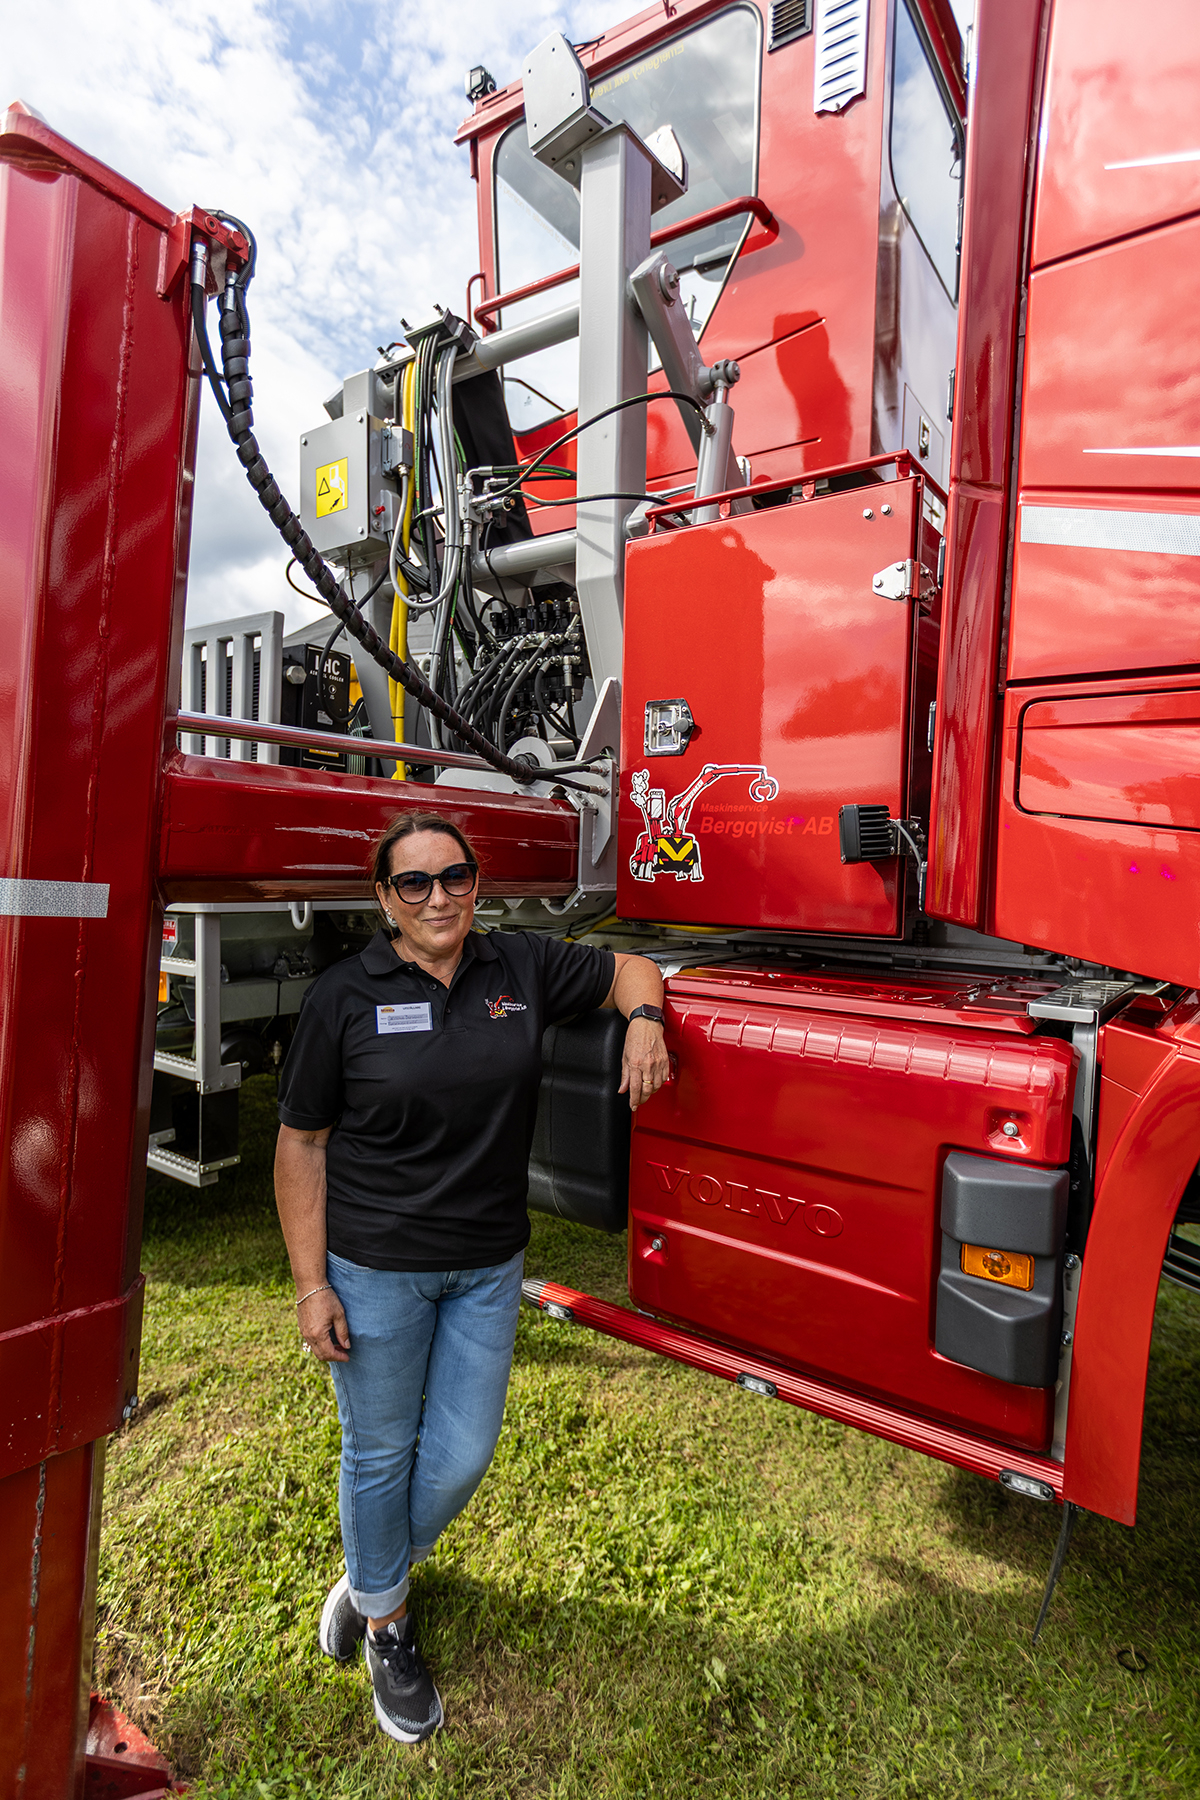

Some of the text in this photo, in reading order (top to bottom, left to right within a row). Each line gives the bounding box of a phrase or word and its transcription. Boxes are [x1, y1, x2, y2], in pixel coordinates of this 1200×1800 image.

[700, 803, 769, 813] Maskinservice
[699, 816, 834, 838] Bergqvist AB
[646, 1160, 844, 1239] VOLVO
